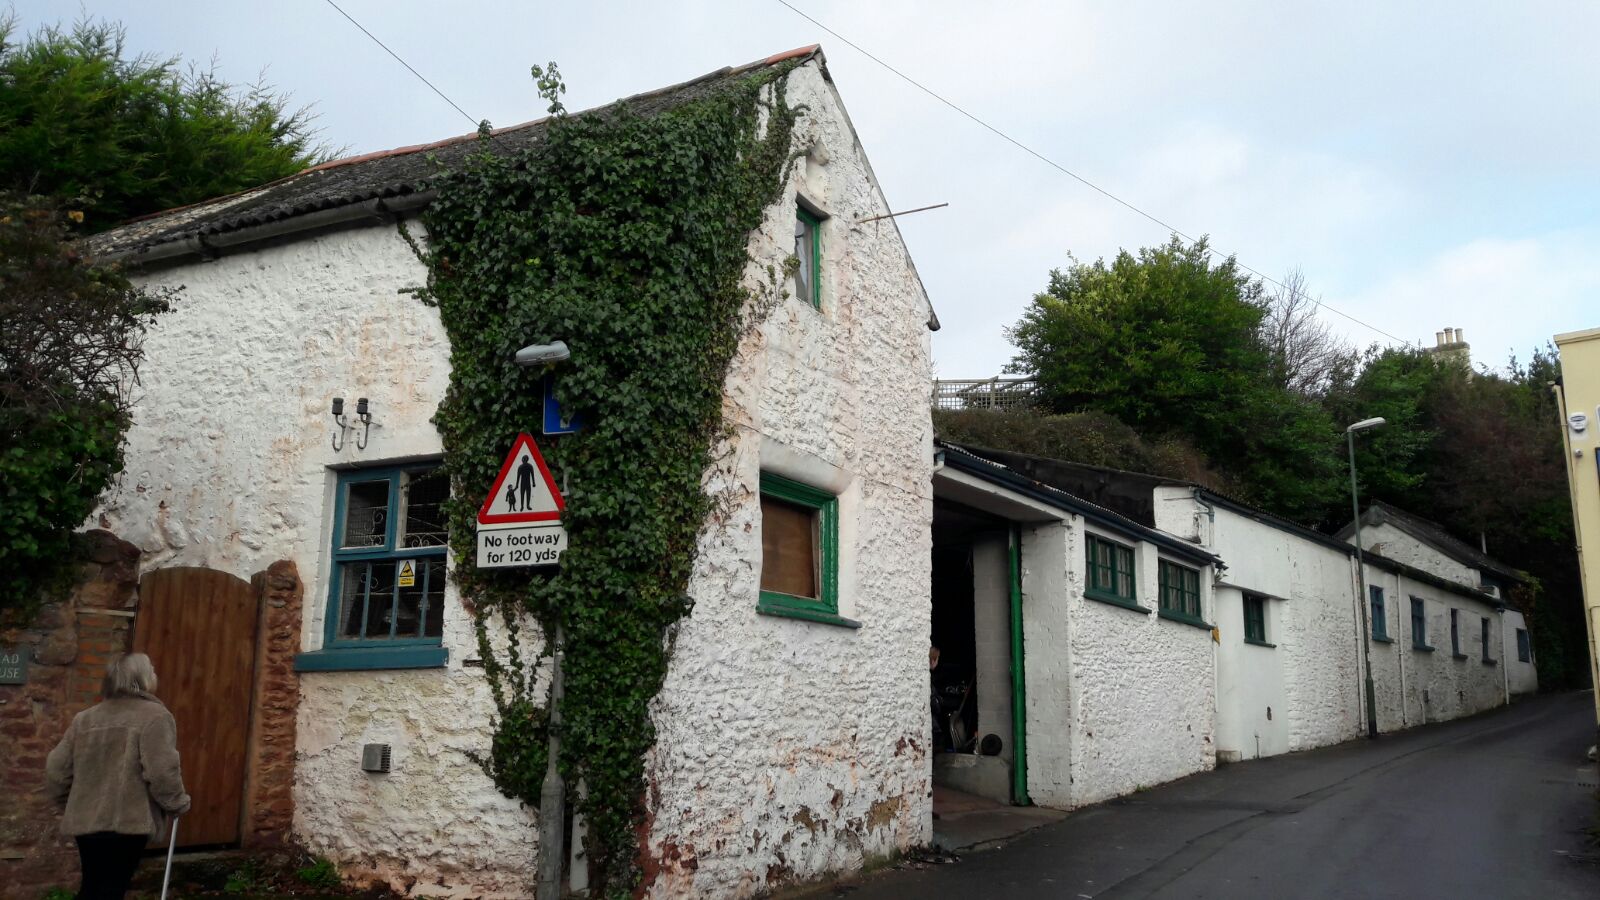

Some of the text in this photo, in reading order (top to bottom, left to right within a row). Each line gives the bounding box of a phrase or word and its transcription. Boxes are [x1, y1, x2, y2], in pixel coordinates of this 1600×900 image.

[485, 533, 560, 547] No footway
[487, 548, 557, 563] for 120 yds
